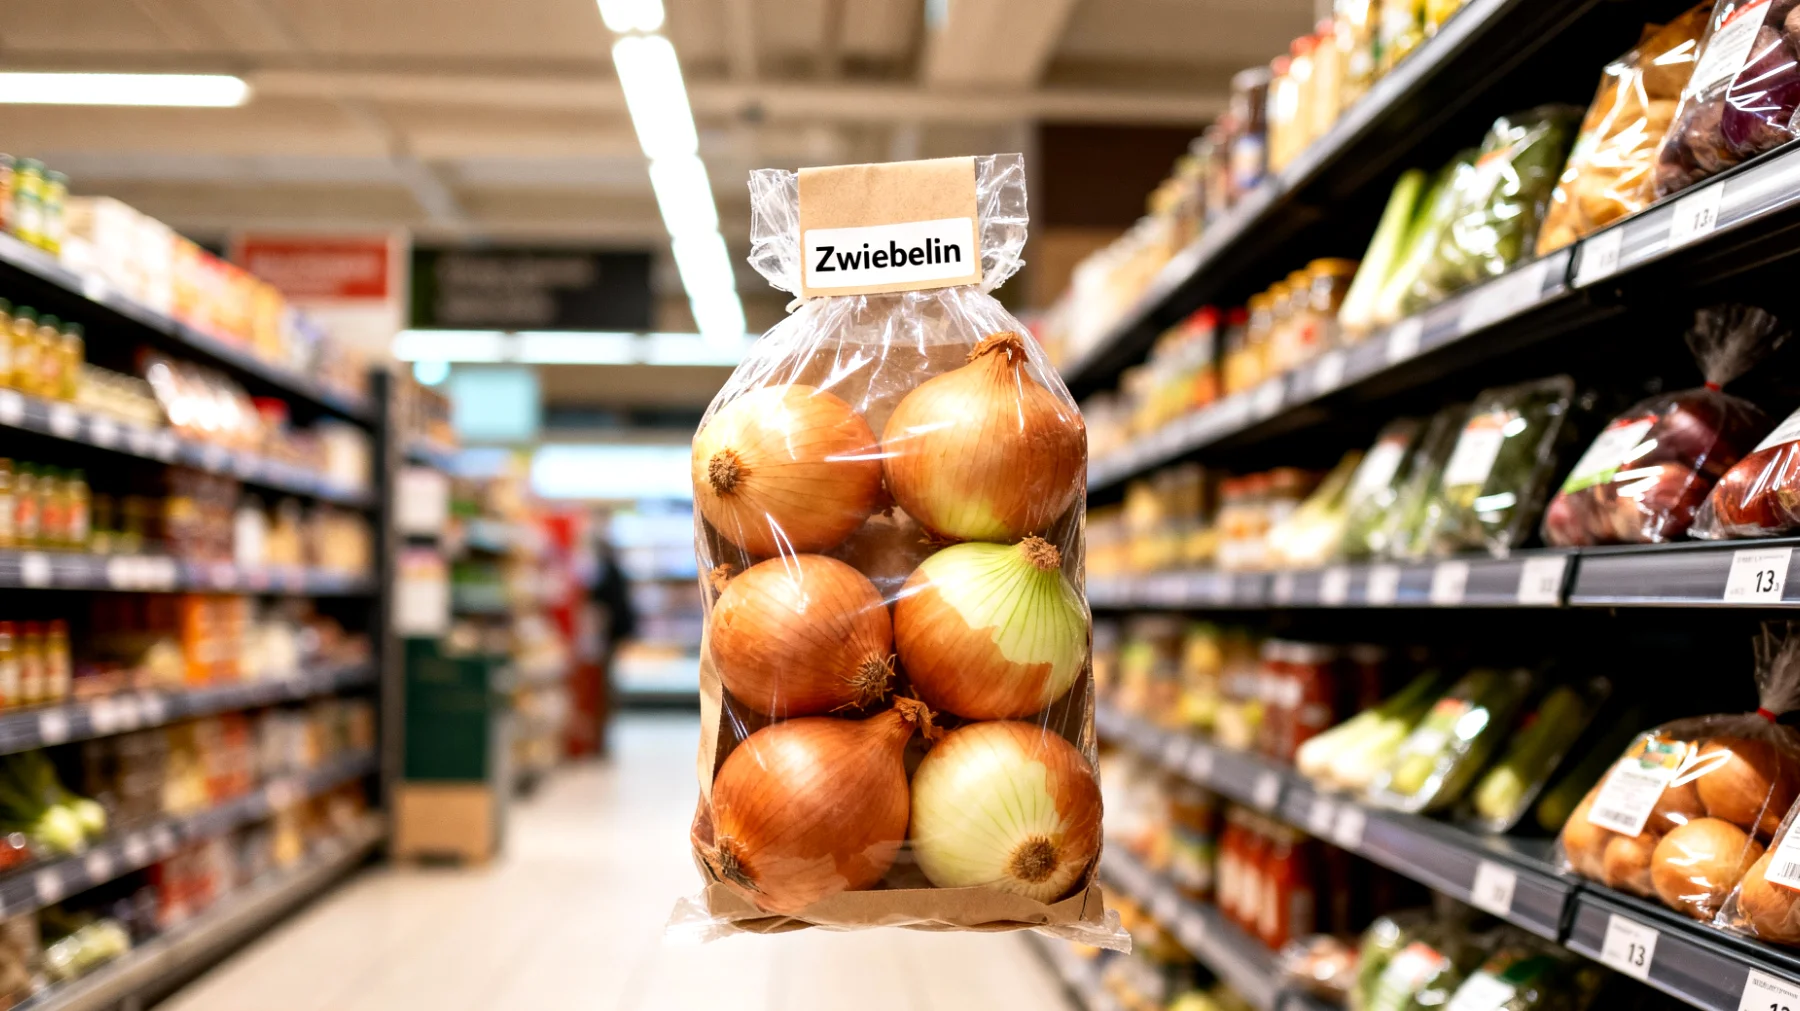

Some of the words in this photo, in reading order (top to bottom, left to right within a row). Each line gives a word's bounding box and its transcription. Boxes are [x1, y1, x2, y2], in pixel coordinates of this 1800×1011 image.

[815, 237, 961, 272] Zwiebelin
[1756, 569, 1775, 593] 13
[1627, 943, 1646, 967] 13
